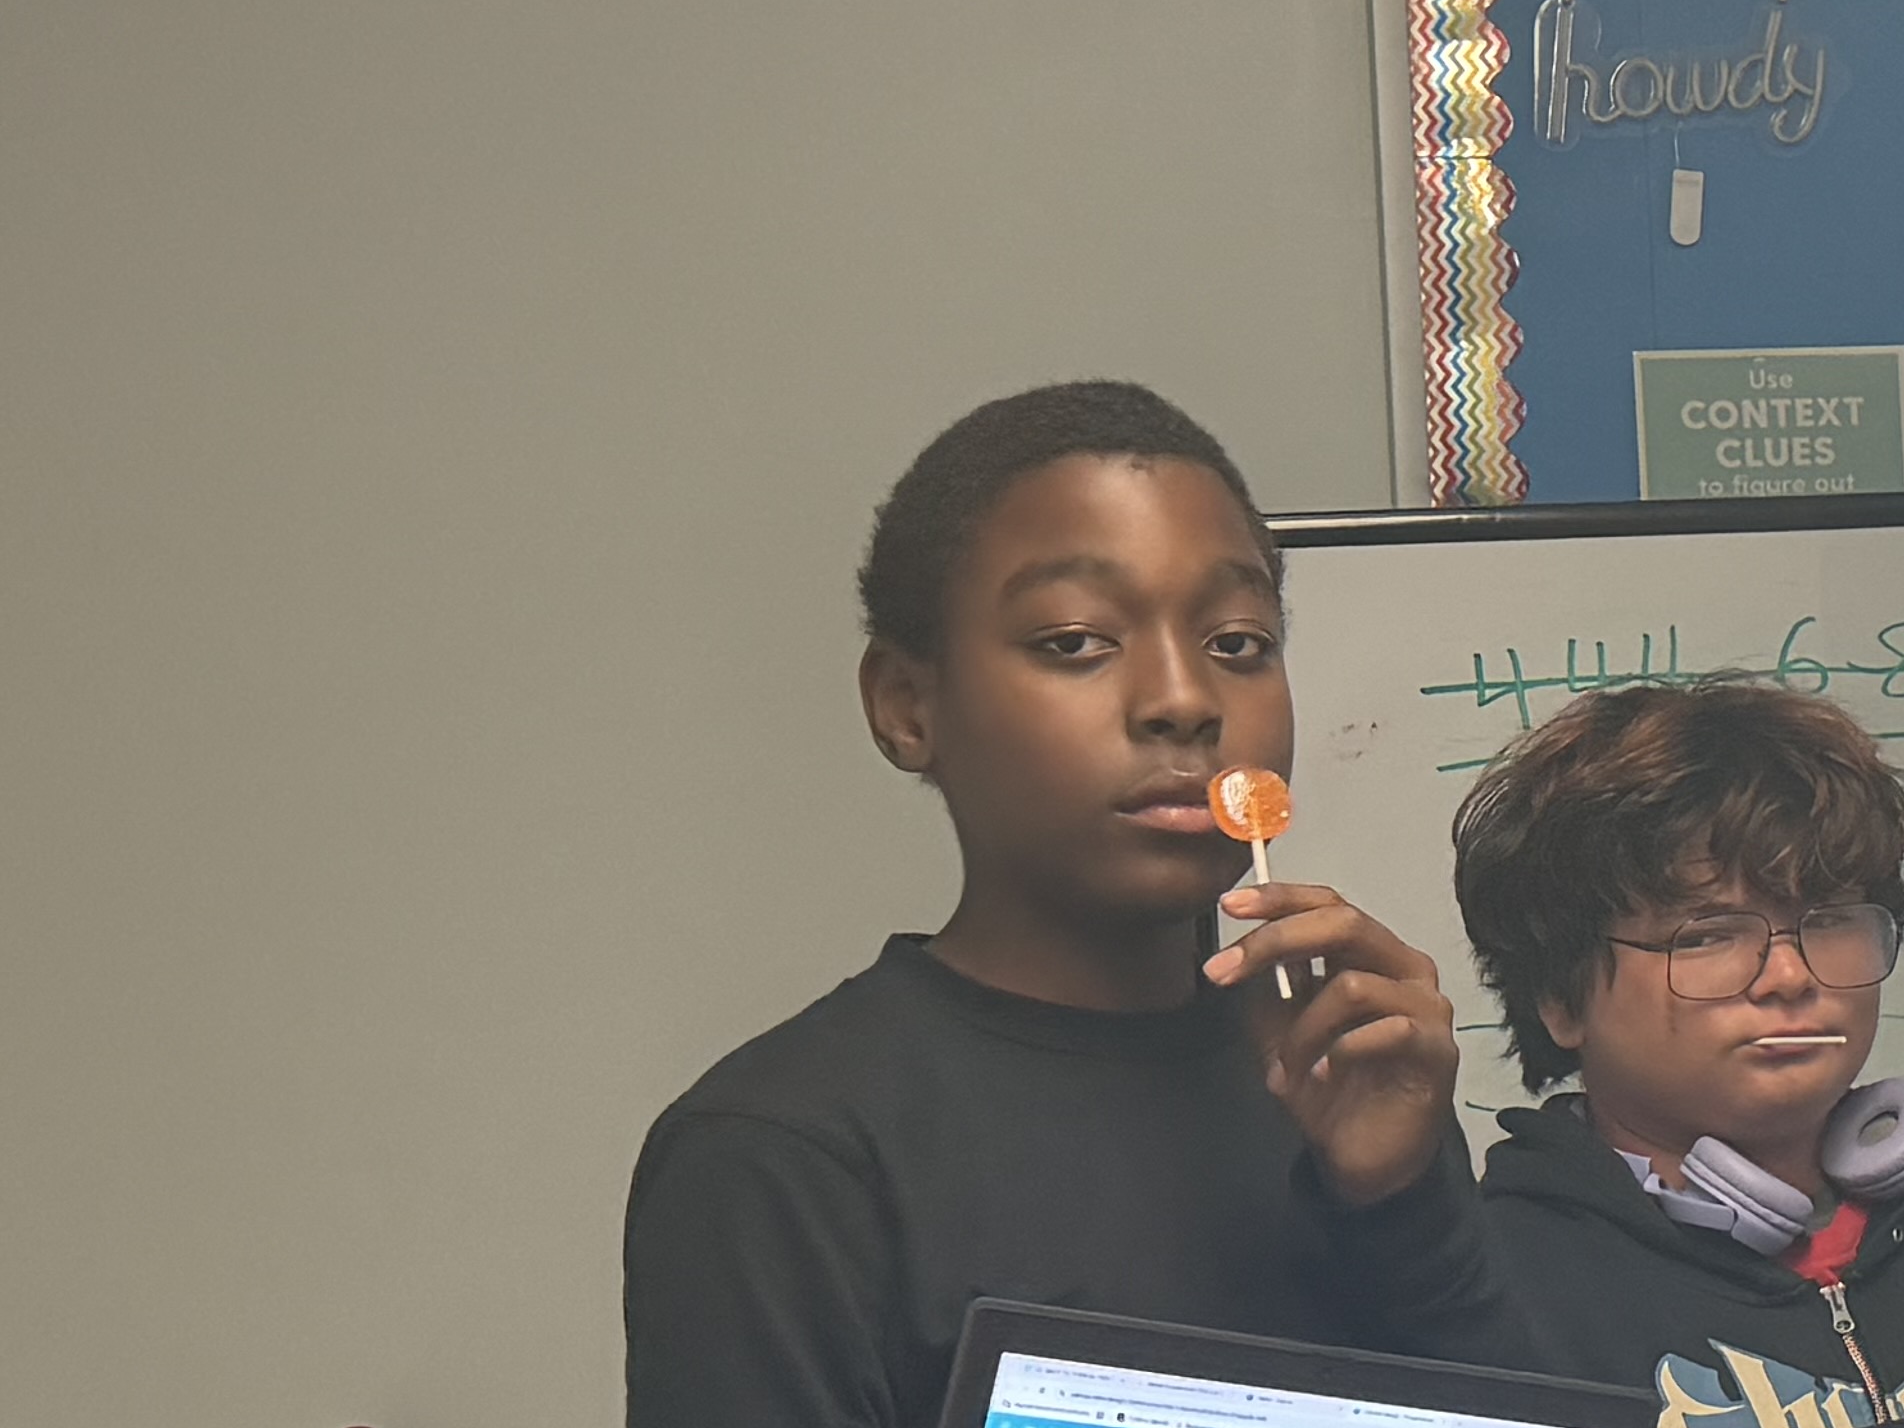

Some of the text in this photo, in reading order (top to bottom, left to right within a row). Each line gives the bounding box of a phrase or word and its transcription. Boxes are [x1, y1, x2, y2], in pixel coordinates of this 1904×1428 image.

[1748, 368, 1794, 391] Use
[1681, 397, 1865, 430] CONTEXT
[1715, 437, 1836, 470] CLUES
[1698, 473, 1856, 495] to figure out
